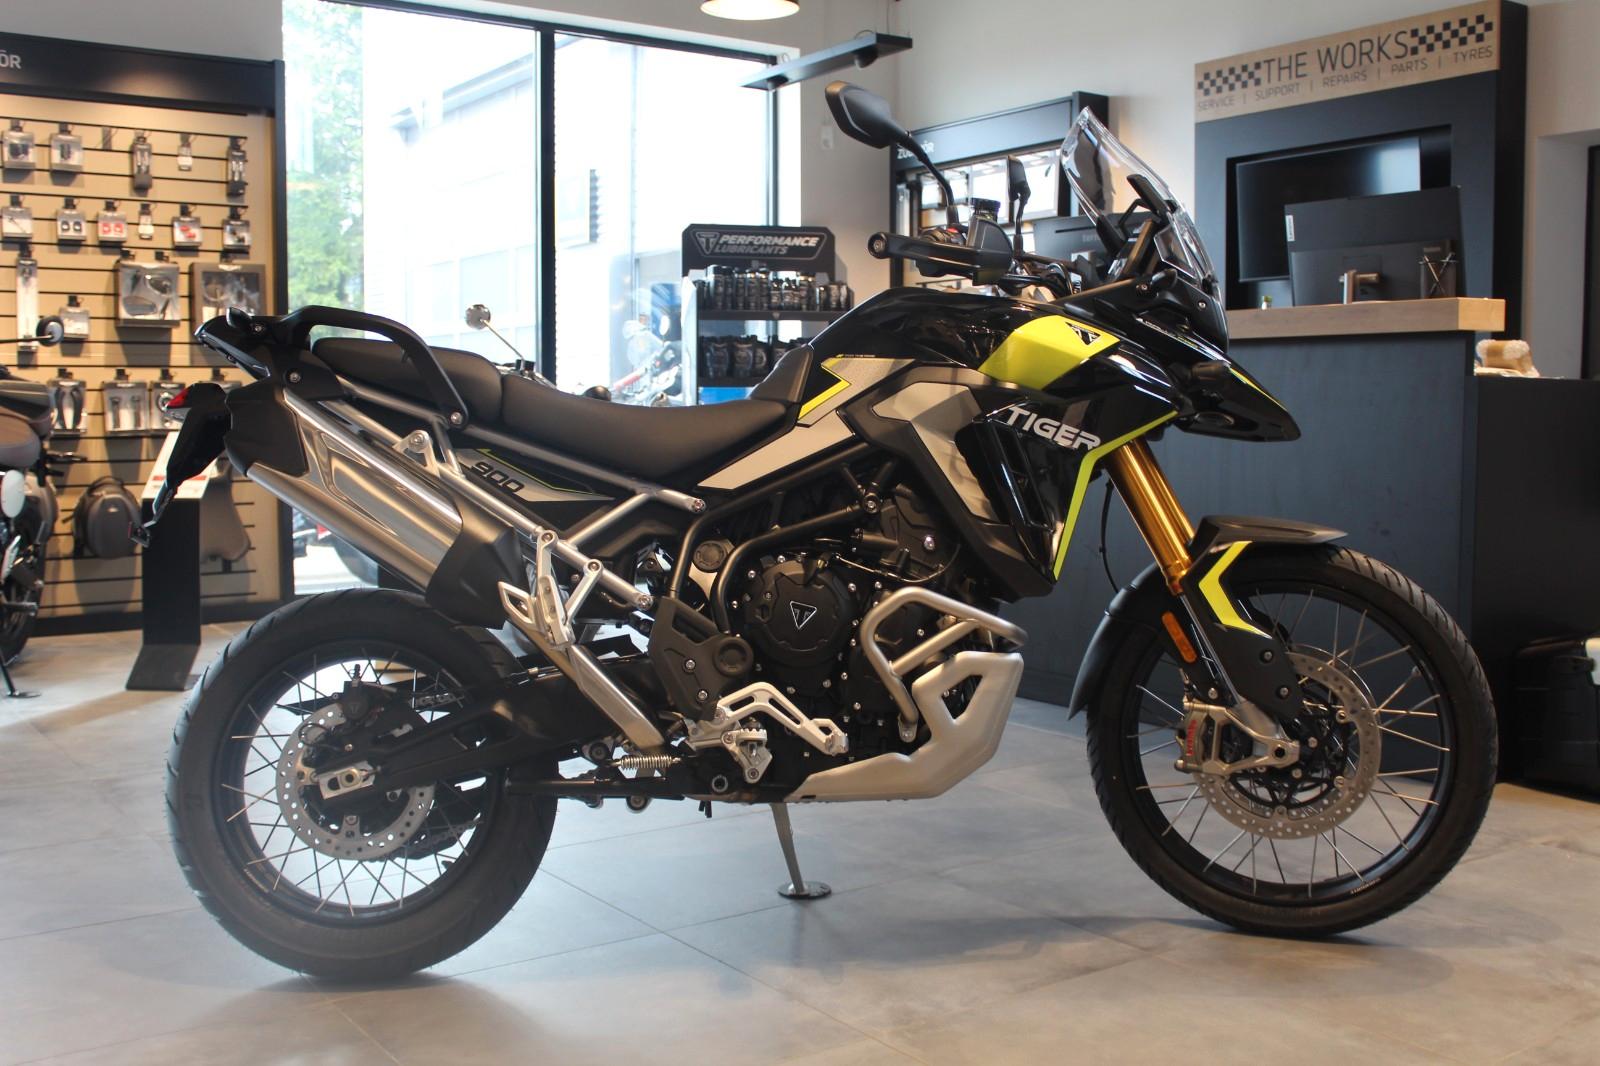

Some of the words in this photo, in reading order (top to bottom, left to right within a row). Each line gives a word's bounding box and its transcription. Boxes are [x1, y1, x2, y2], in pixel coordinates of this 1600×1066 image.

[1263, 51, 1308, 84] THE
[1317, 31, 1409, 73] WORKS
[1197, 95, 1235, 111] SERVICE
[1255, 83, 1300, 102] SUPPORT
[1322, 70, 1368, 88] REPAIRS
[1391, 58, 1428, 74] PARTS
[1453, 45, 1493, 63] TYRES
[714, 244, 788, 255] LUBRICANTS
[719, 234, 820, 247] PERFORMANCE
[1006, 405, 1101, 450] TIGER
[470, 461, 525, 493] 900
